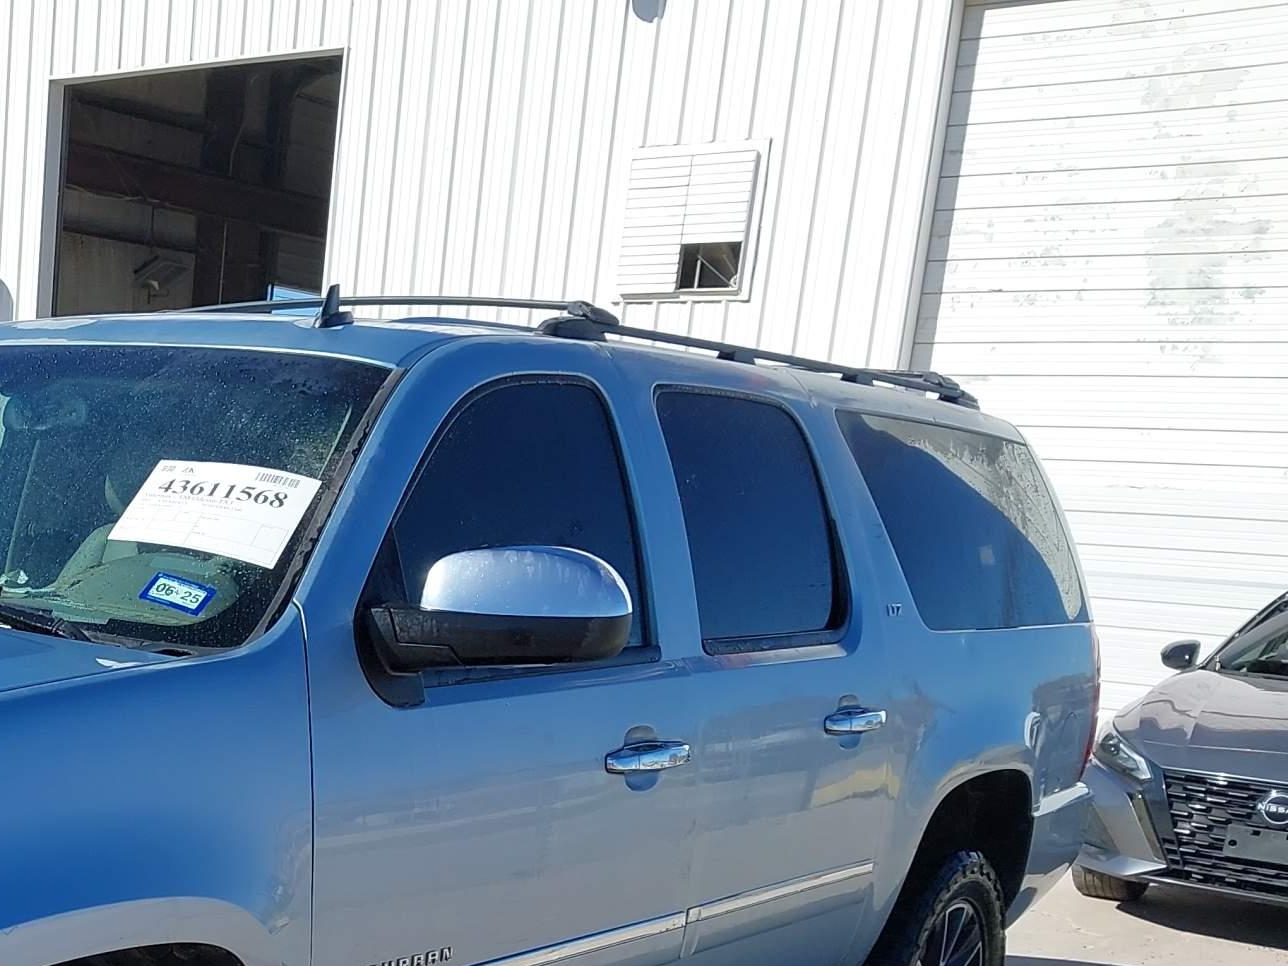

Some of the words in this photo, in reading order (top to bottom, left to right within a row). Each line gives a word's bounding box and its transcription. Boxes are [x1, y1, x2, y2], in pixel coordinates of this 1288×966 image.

[157, 477, 289, 509] 43611568
[156, 582, 177, 596] 06
[180, 591, 203, 604] 25
